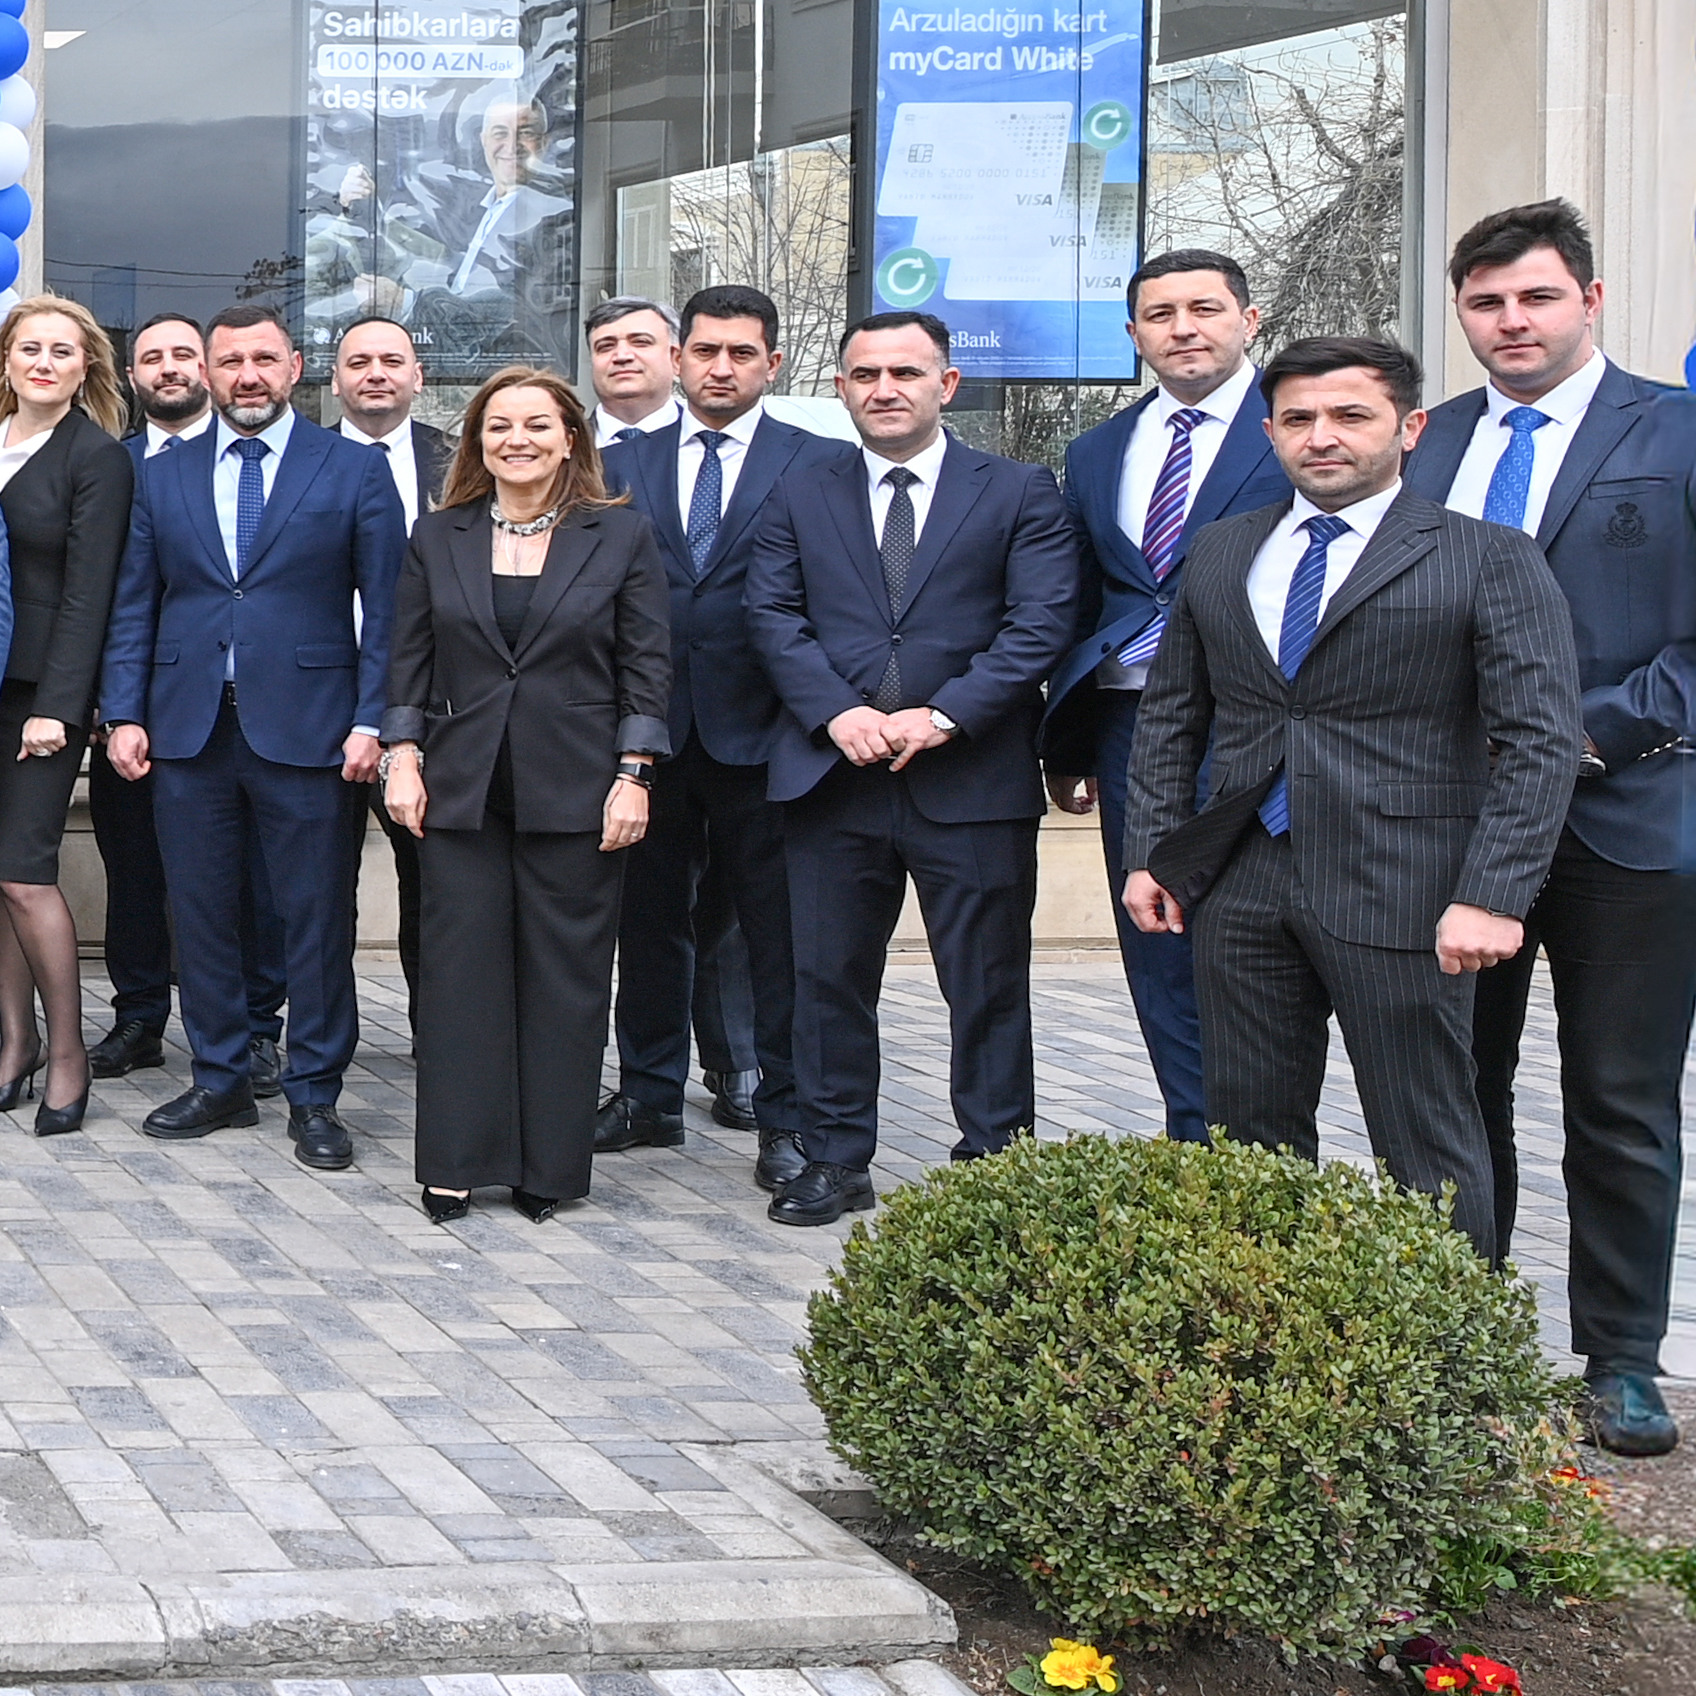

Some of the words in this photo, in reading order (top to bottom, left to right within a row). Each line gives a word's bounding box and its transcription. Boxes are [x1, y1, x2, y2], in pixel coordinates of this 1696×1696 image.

[322, 11, 518, 38] Sahibkarlara
[889, 7, 1043, 38] Arzuladığın
[1054, 8, 1107, 33] kart
[326, 51, 370, 71] 100
[378, 51, 426, 71] 000
[889, 46, 1002, 76] myCard
[1011, 46, 1094, 72] White
[322, 84, 428, 110] dəstək
[1015, 193, 1053, 206] VISA
[1049, 234, 1088, 248] VISA
[1083, 276, 1123, 289] VISA
